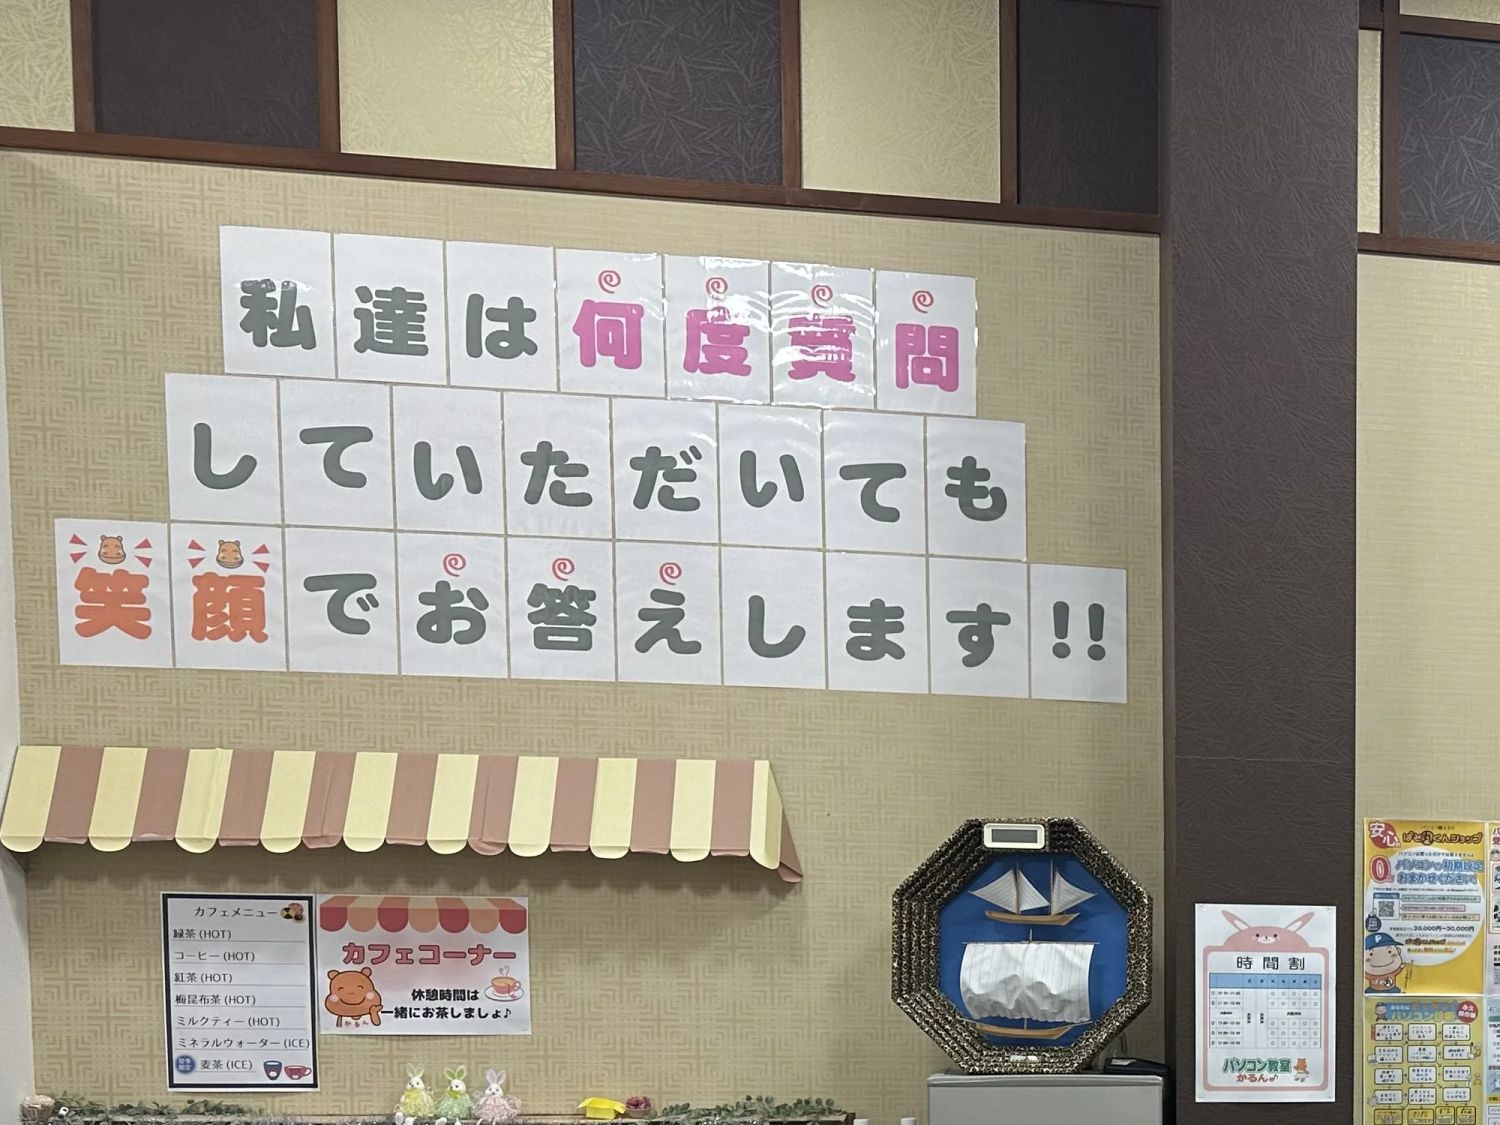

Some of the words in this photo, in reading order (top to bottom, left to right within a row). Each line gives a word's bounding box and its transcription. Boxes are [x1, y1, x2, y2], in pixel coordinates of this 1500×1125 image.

[241, 280, 960, 392] 私達は何度質問
[195, 422, 1007, 523] していただいても
[73, 567, 1106, 668] 笑顔でお答えします!!
[194, 906, 278, 918] カフェメニュー
[199, 929, 232, 940] (HOT)
[175, 952, 220, 960] コーヒー
[223, 951, 256, 962] (HOT)
[342, 942, 517, 966] カフェコーナー
[1236, 956, 1306, 970] 時間割
[174, 972, 198, 983] 紅茶
[200, 972, 233, 983] (HOT)
[224, 995, 256, 1005] (HOT)
[411, 988, 480, 1002] 休憩時間は
[177, 1016, 245, 1026] ミルクティー
[248, 1016, 280, 1027] (HOT)
[178, 1038, 281, 1048] ミネラルウォーター
[284, 1038, 310, 1049] (ICE)
[200, 1060, 224, 1070] 麦茶
[226, 1060, 253, 1070] (ICE)
[1223, 1058, 1291, 1073] パソコン教室
